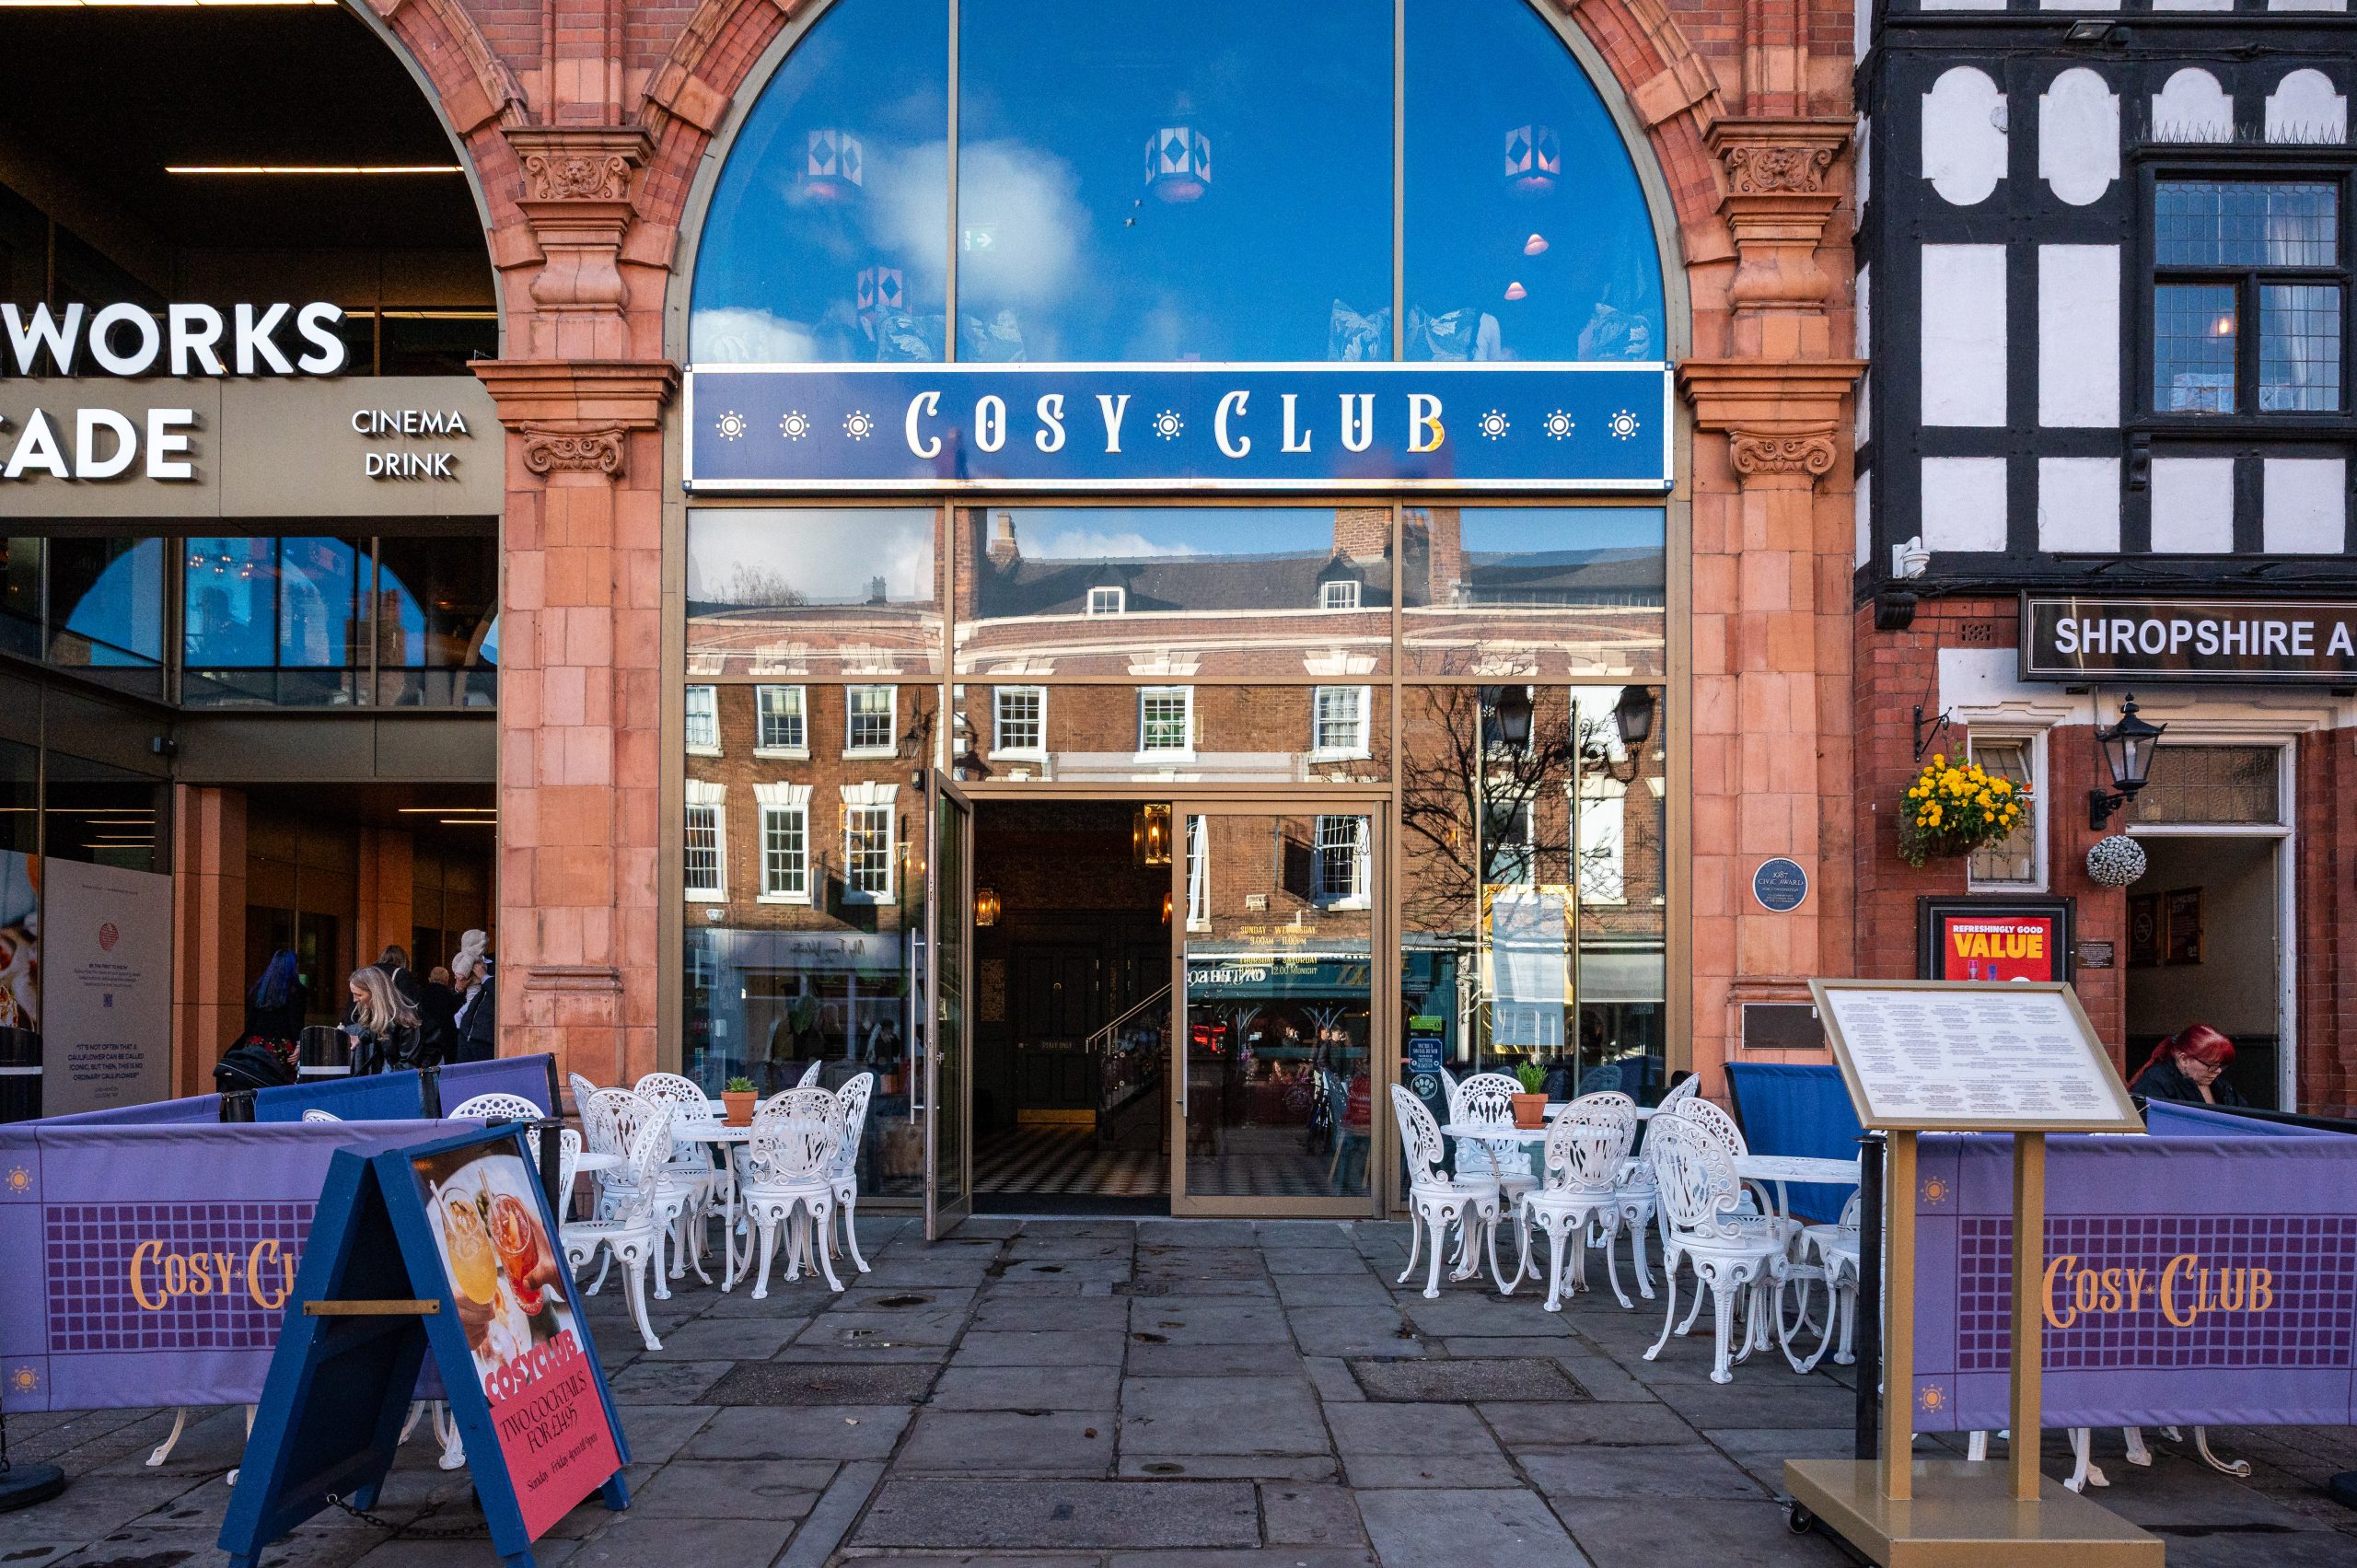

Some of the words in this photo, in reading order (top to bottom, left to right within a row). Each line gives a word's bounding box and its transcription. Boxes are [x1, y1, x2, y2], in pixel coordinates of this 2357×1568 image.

[0, 302, 346, 376] WORKS
[352, 410, 467, 434] CINEMA
[905, 391, 1132, 459] COSY
[1214, 390, 1446, 459] CLUB
[0, 408, 193, 479] ADE
[366, 452, 454, 477] DRINK
[2054, 618, 2315, 656] SHROPSHIRE
[1240, 926, 1266, 934] SUNDAY
[1275, 926, 1316, 934] WEDNESDAY
[1953, 925, 2015, 933] REFRESHINGLY
[1953, 933, 2043, 958] VALUE
[1271, 967, 1288, 975] 12.00
[130, 1240, 236, 1310] COSY
[2042, 1255, 2148, 1328] COSY
[2160, 1254, 2273, 1327] CLUB
[500, 1409, 530, 1442] TWO
[530, 1370, 587, 1423] COCKTAILS
[527, 1421, 553, 1453] FOR
[552, 1402, 578, 1437] £14.95
[527, 1470, 548, 1492] Sunday
[551, 1456, 568, 1473] Friday
